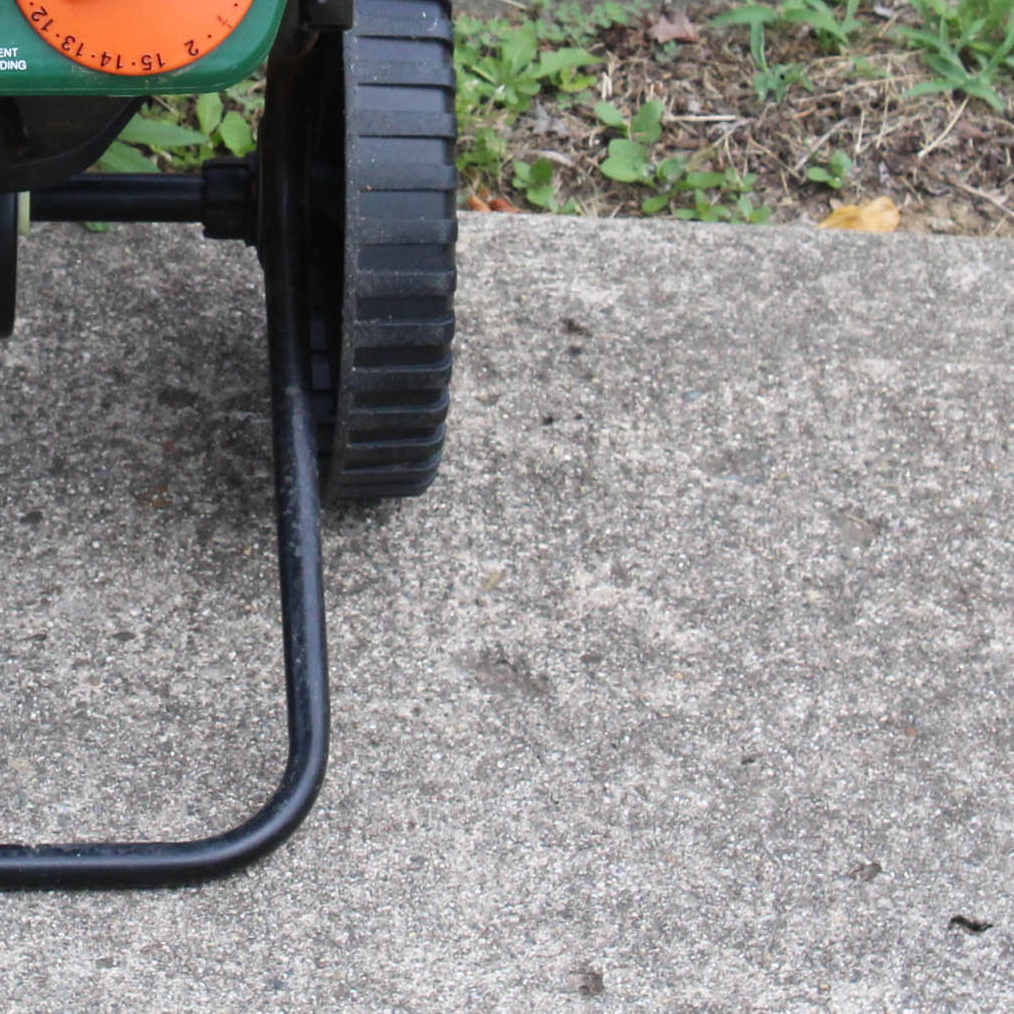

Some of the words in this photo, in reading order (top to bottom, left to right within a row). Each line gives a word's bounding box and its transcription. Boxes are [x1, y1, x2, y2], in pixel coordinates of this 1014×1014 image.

[31, 6, 54, 32] 12
[61, 35, 85, 57] 13
[184, 39, 199, 57] 2
[100, 51, 123, 70] 14
[141, 52, 166, 71] 15
